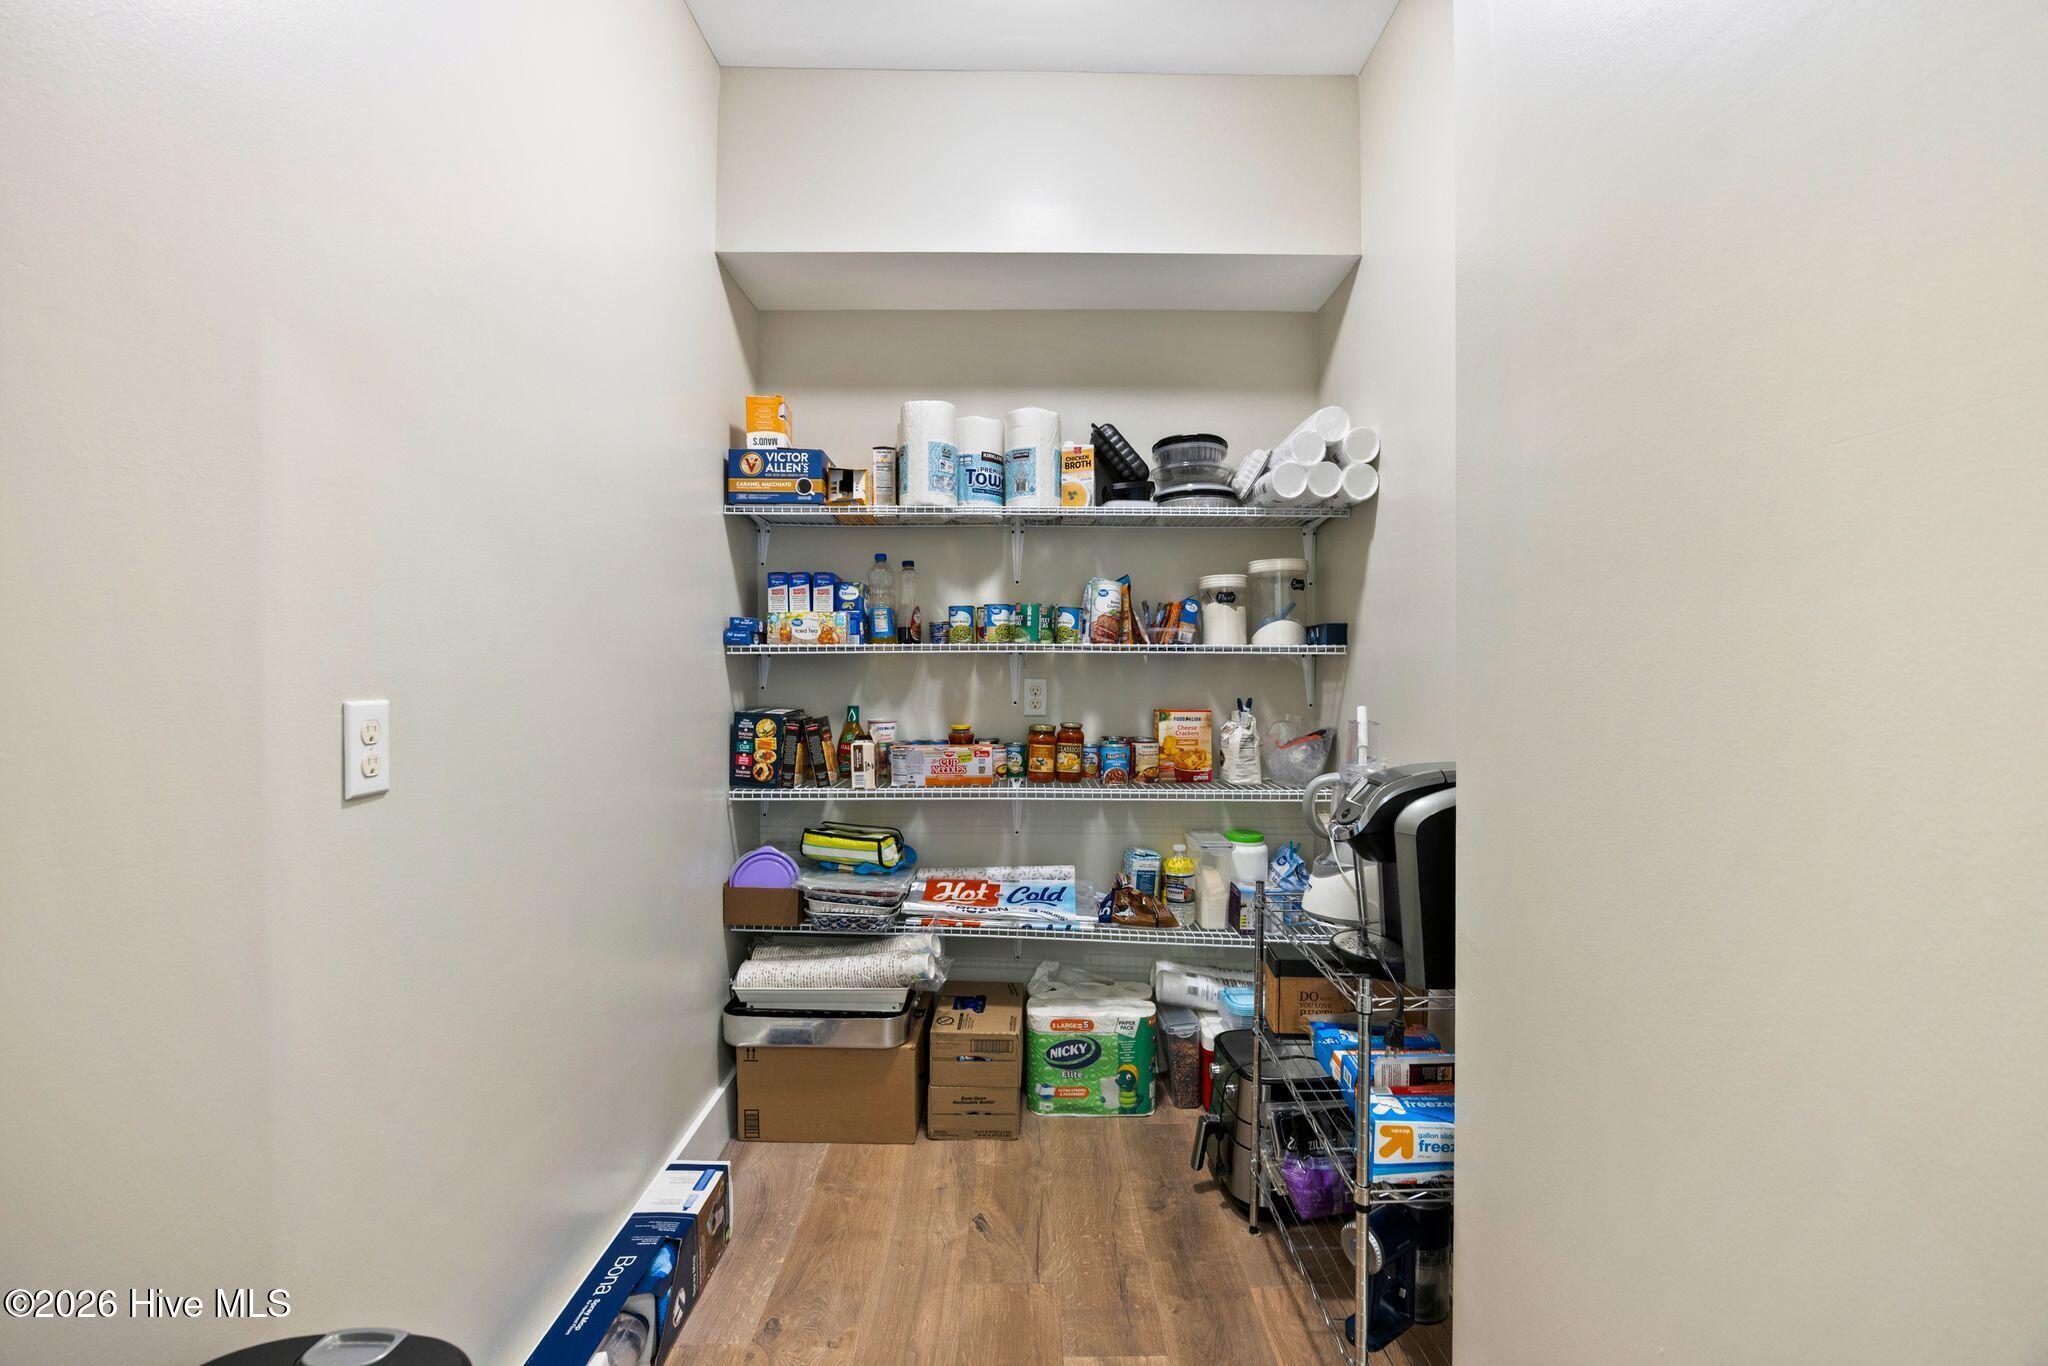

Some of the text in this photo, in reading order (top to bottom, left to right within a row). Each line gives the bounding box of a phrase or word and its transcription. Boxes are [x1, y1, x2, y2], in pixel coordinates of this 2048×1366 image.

[765, 452, 809, 462] VICTOR
[765, 463, 809, 473] ALLEN'S
[1064, 462, 1092, 470] BROTH
[939, 758, 960, 766] CUP
[933, 882, 989, 901] Hot
[1006, 886, 1067, 904] Cold
[1300, 991, 1319, 1002] DO
[1050, 1042, 1088, 1059] NICKY
[1061, 1070, 1083, 1078] Elite
[593, 1255, 637, 1296] Bona
[574, 1298, 601, 1331] Spray Mop
